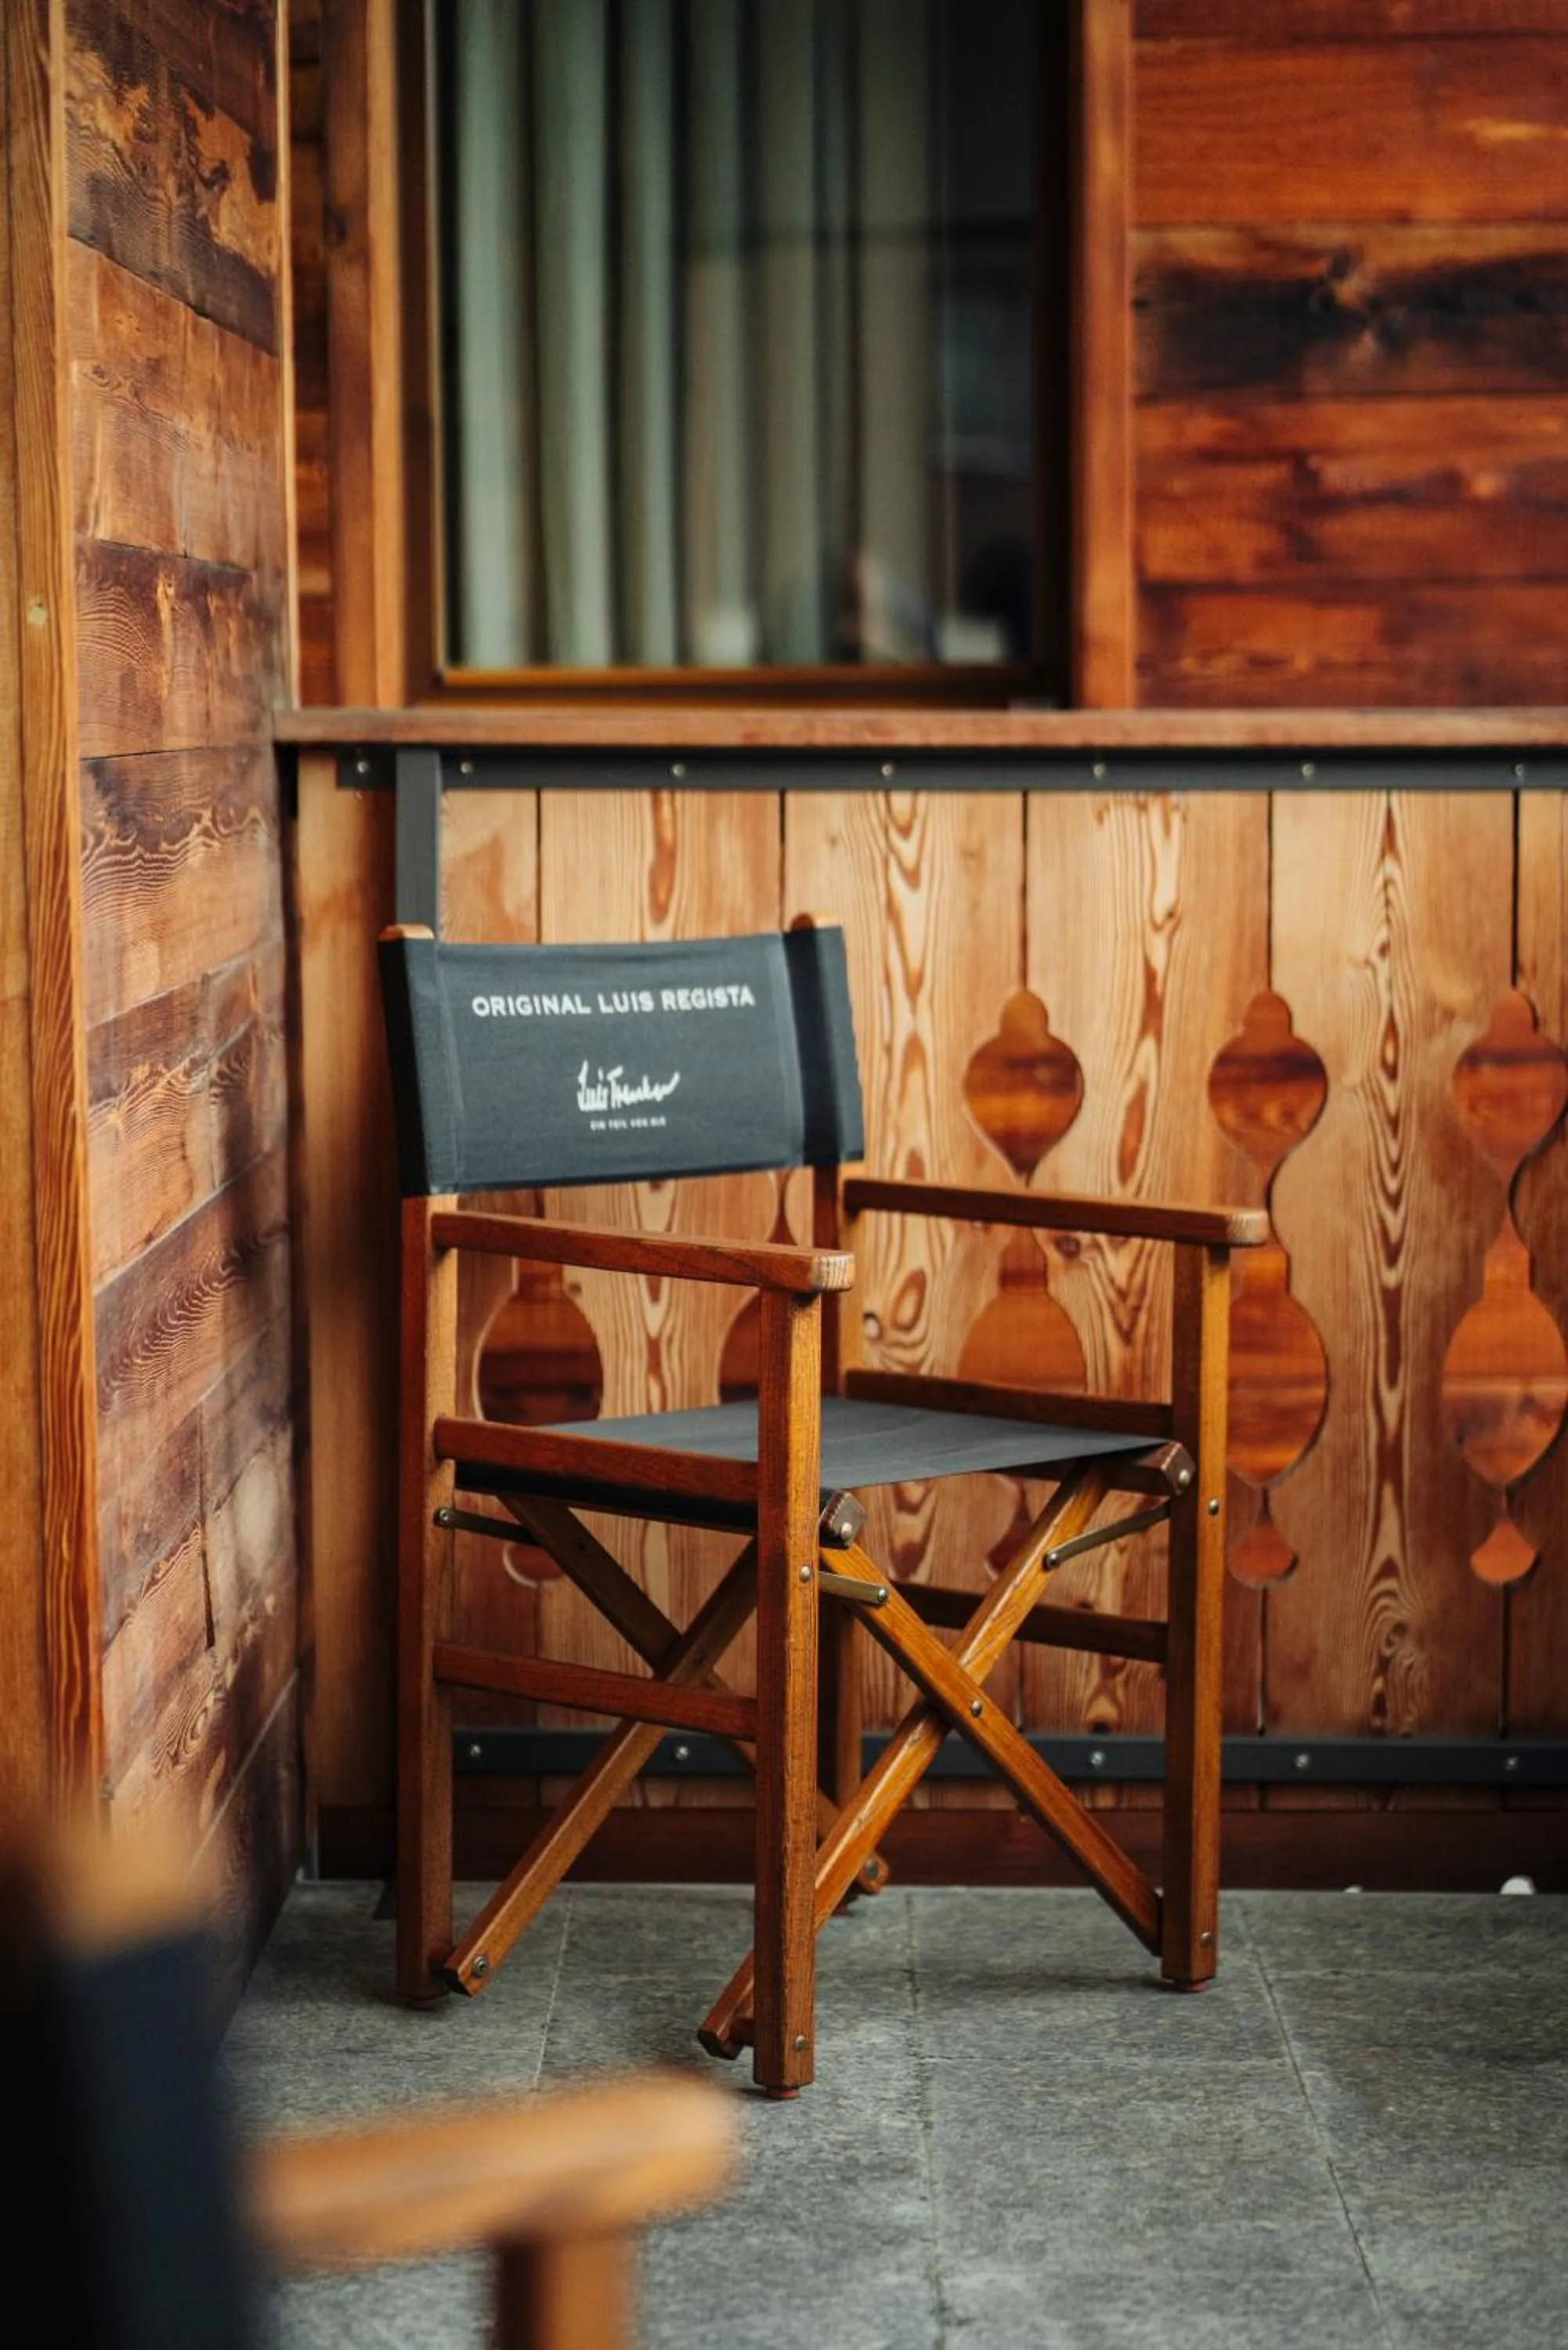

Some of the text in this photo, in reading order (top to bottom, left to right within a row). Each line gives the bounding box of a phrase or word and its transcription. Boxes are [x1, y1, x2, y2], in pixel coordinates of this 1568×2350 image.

[471, 984, 756, 1018] ORIGINAL LUIS REGISTA
